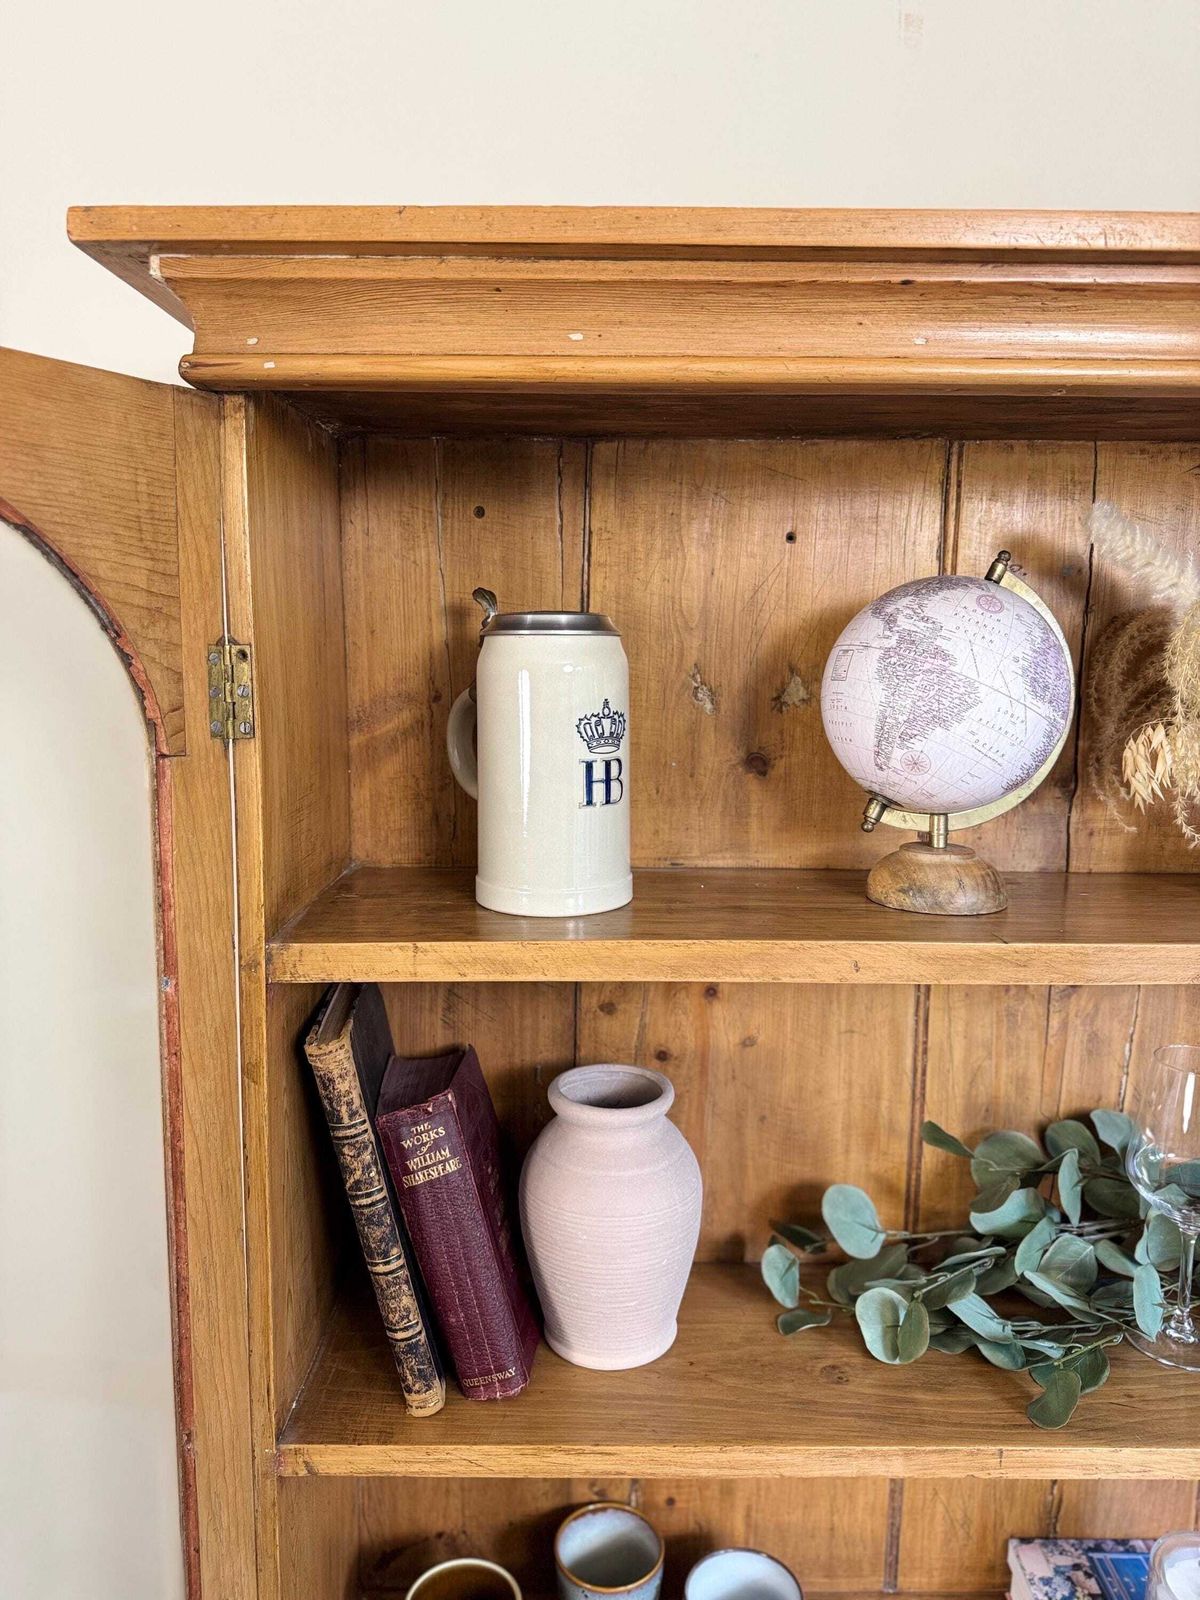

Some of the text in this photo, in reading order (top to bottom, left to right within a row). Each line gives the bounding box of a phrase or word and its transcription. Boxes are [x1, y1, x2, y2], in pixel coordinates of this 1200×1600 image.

[578, 757, 623, 807] HB
[401, 1126, 446, 1149] WORKS
[411, 1122, 431, 1135] THE
[405, 1146, 451, 1171] WILLIAM
[402, 1157, 462, 1188] SHAKESPEARE
[463, 1367, 516, 1387] QUEENSWAY
